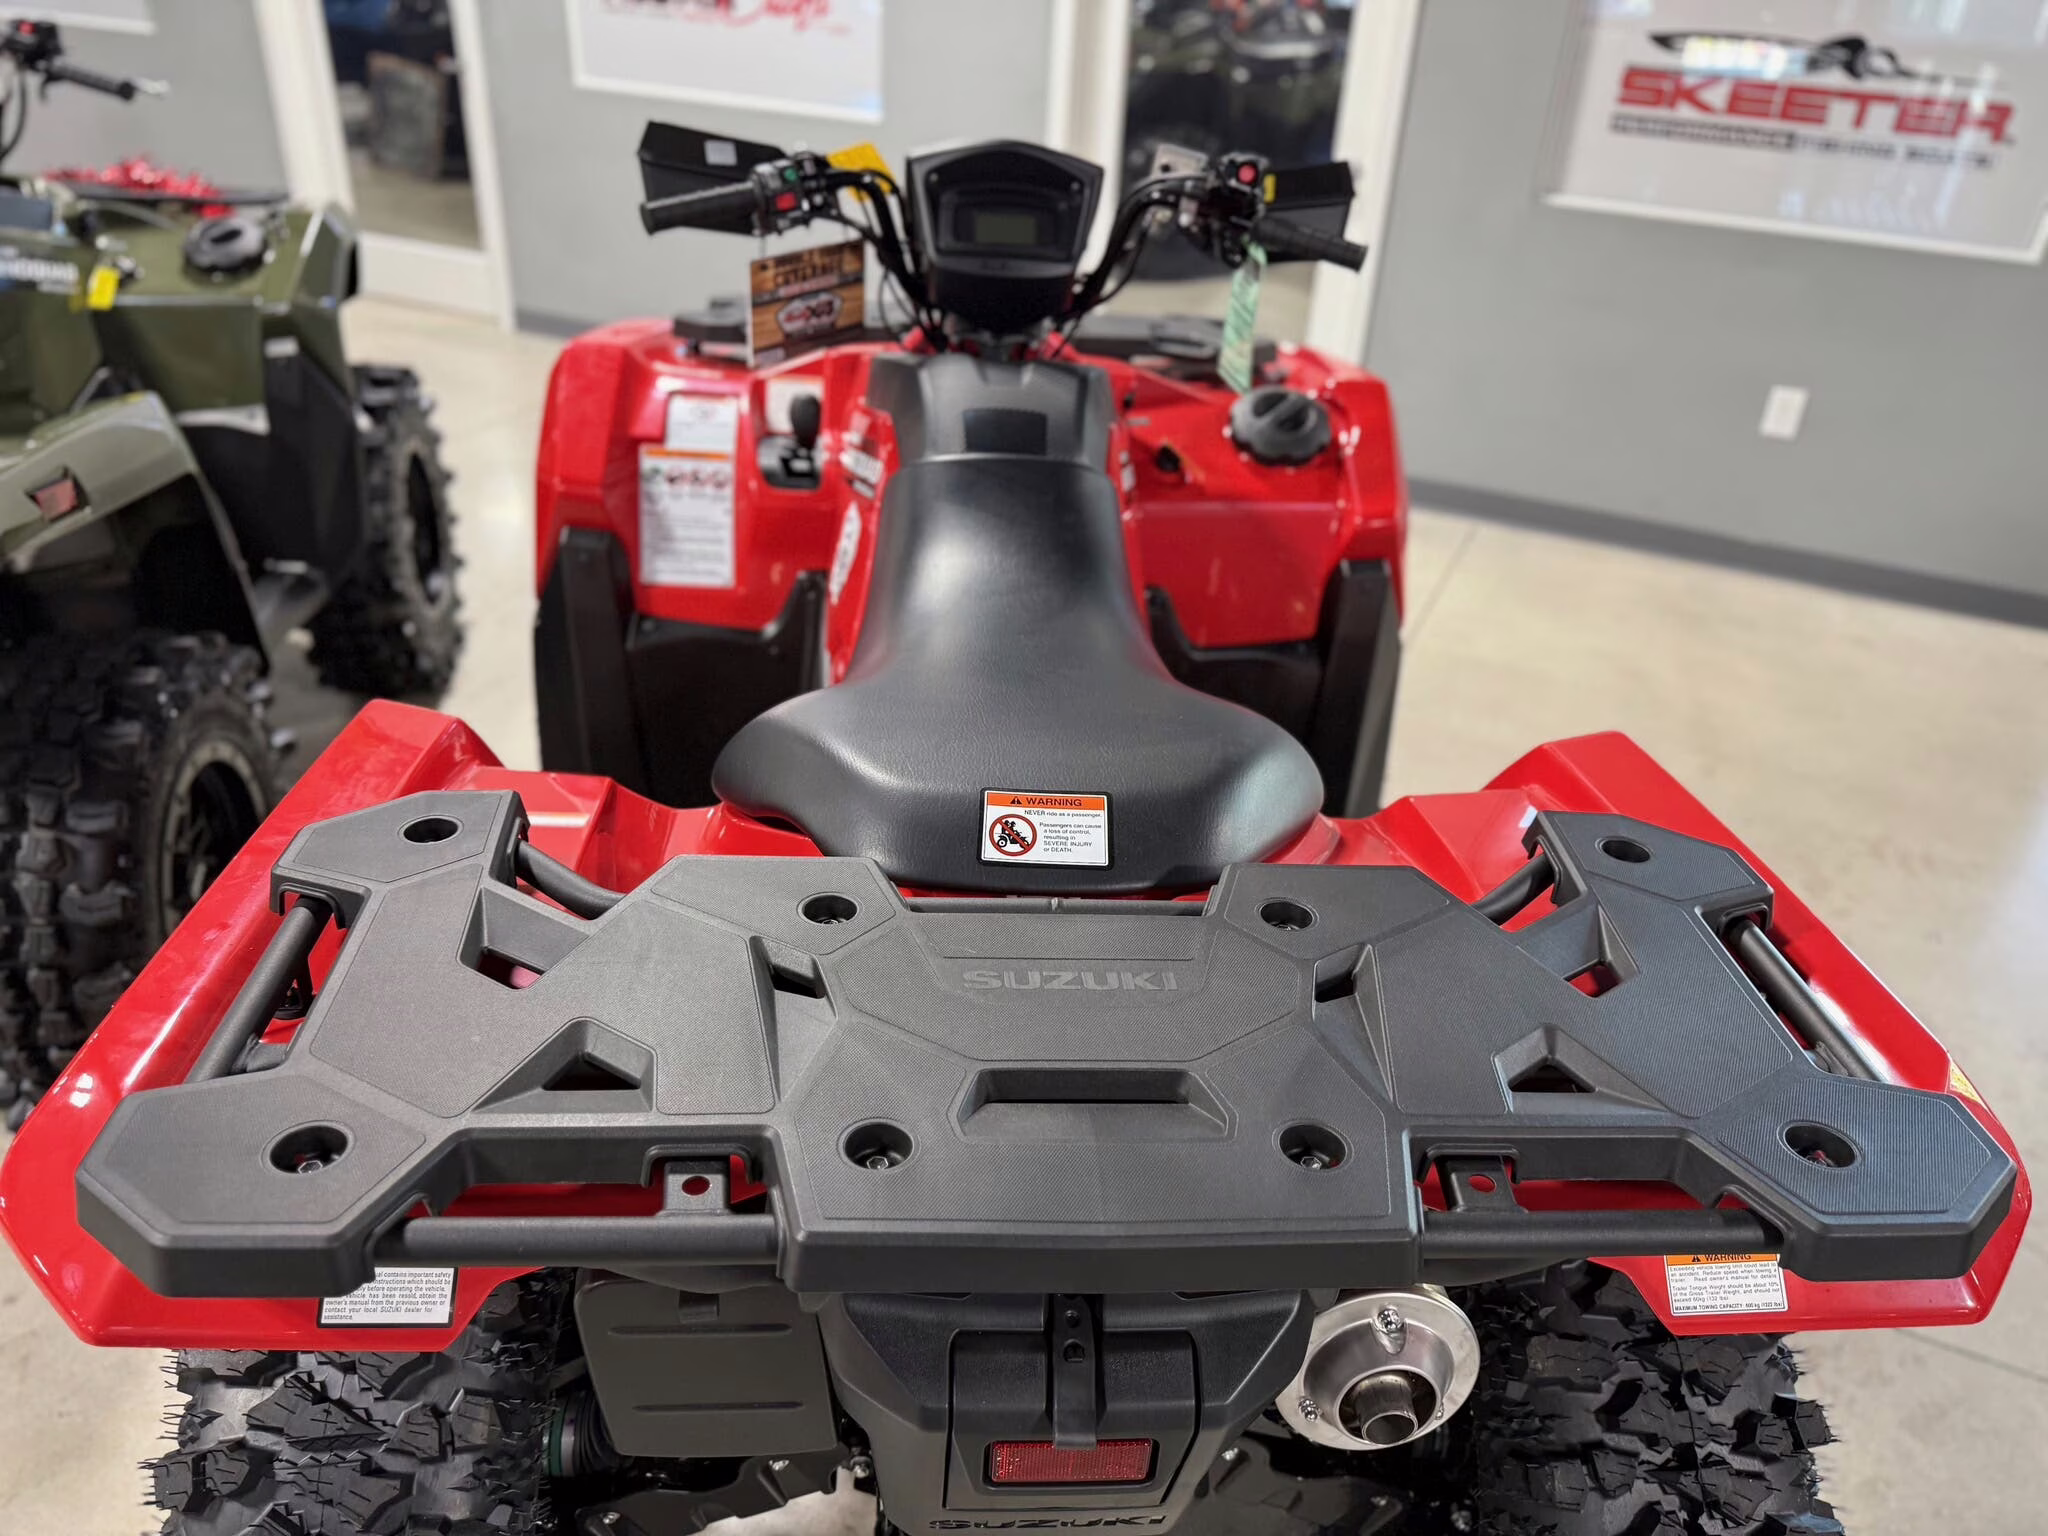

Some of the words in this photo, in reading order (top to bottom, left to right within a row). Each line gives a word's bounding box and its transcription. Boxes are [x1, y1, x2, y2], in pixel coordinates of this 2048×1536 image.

[1618, 66, 2014, 143] SKEETER
[1026, 798, 1082, 806] WARNING
[963, 969, 1178, 991] SUZUKI
[929, 1515, 1167, 1530] SUZUKI
